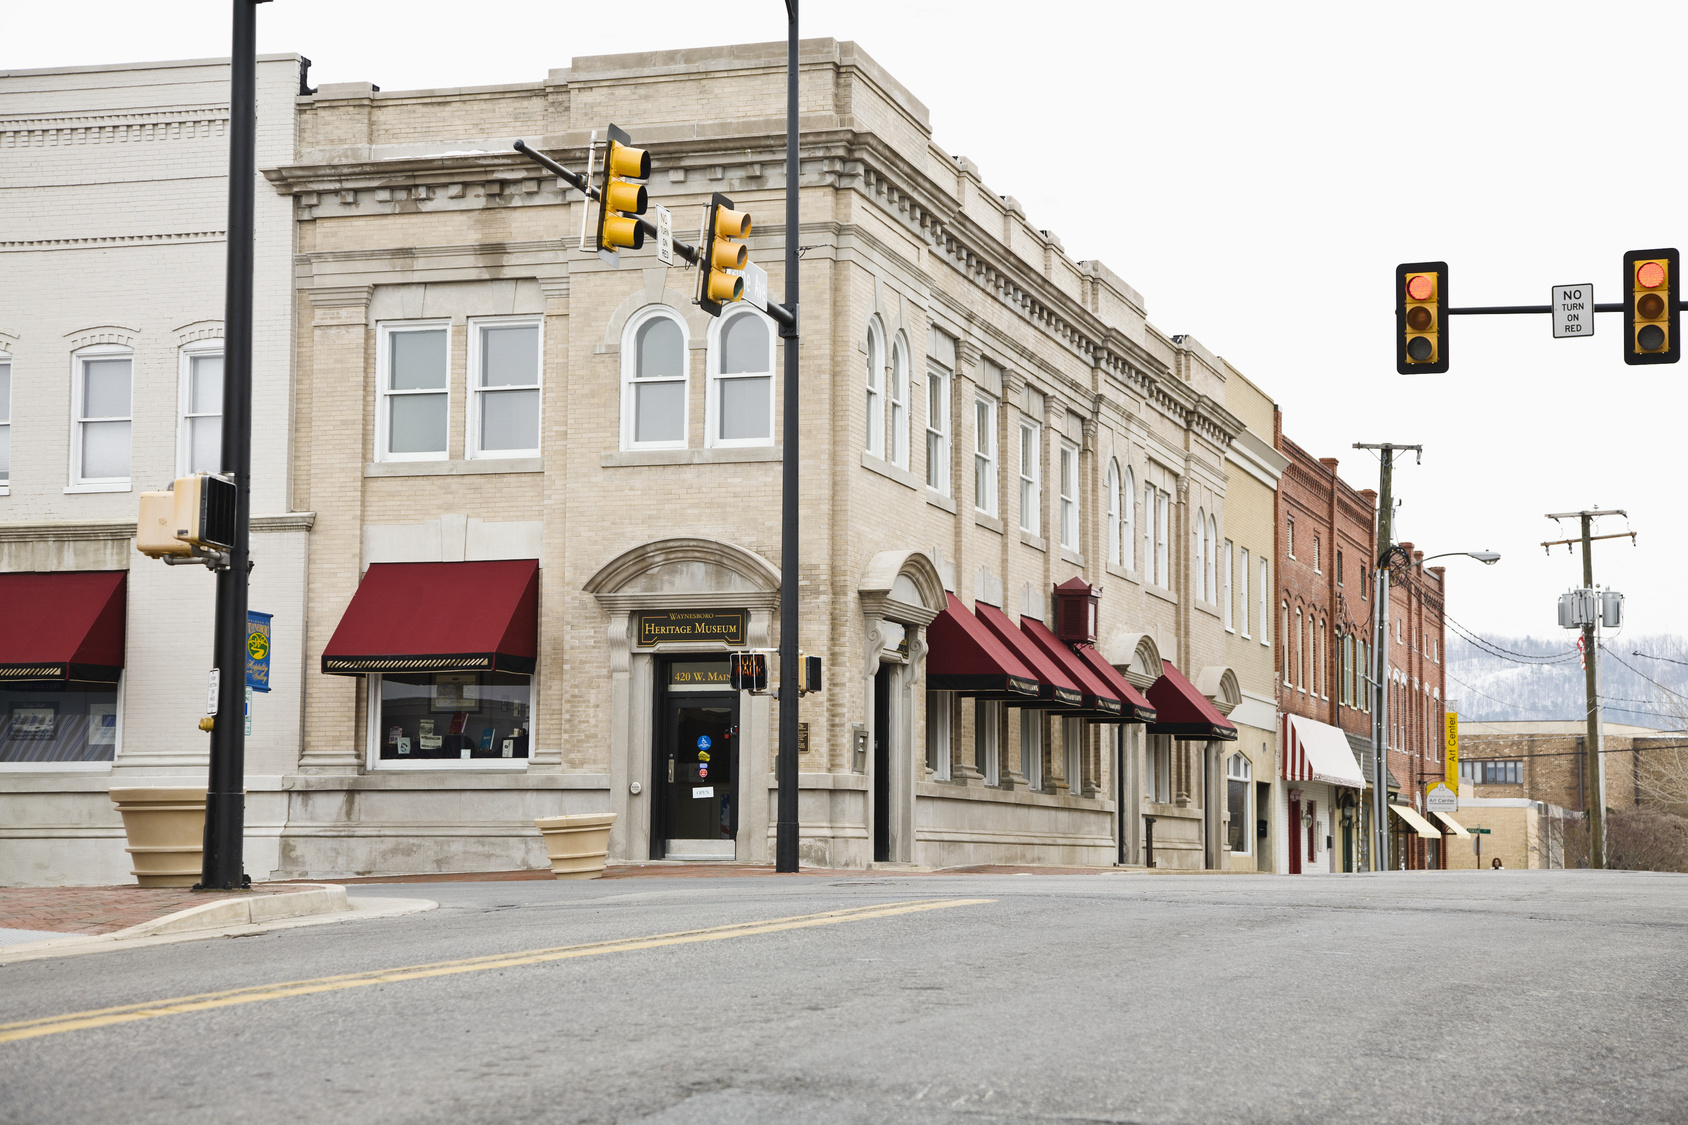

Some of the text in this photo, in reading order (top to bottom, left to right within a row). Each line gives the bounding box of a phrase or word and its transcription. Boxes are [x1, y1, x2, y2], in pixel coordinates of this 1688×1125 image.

[660, 212, 668, 225] NO
[660, 225, 670, 237] TURN
[662, 238, 668, 247] ON
[661, 248, 669, 259] RED
[754, 273, 766, 302] Ave
[1563, 289, 1582, 301] NO
[1561, 303, 1585, 312] TURN
[1566, 313, 1580, 322] ON
[1564, 324, 1582, 333] RED
[645, 622, 737, 634] HERITAGE MUSEUM
[674, 672, 691, 681] 420
[693, 672, 706, 681] W.
[1448, 716, 1456, 746] Center
[1448, 750, 1456, 762] Art
